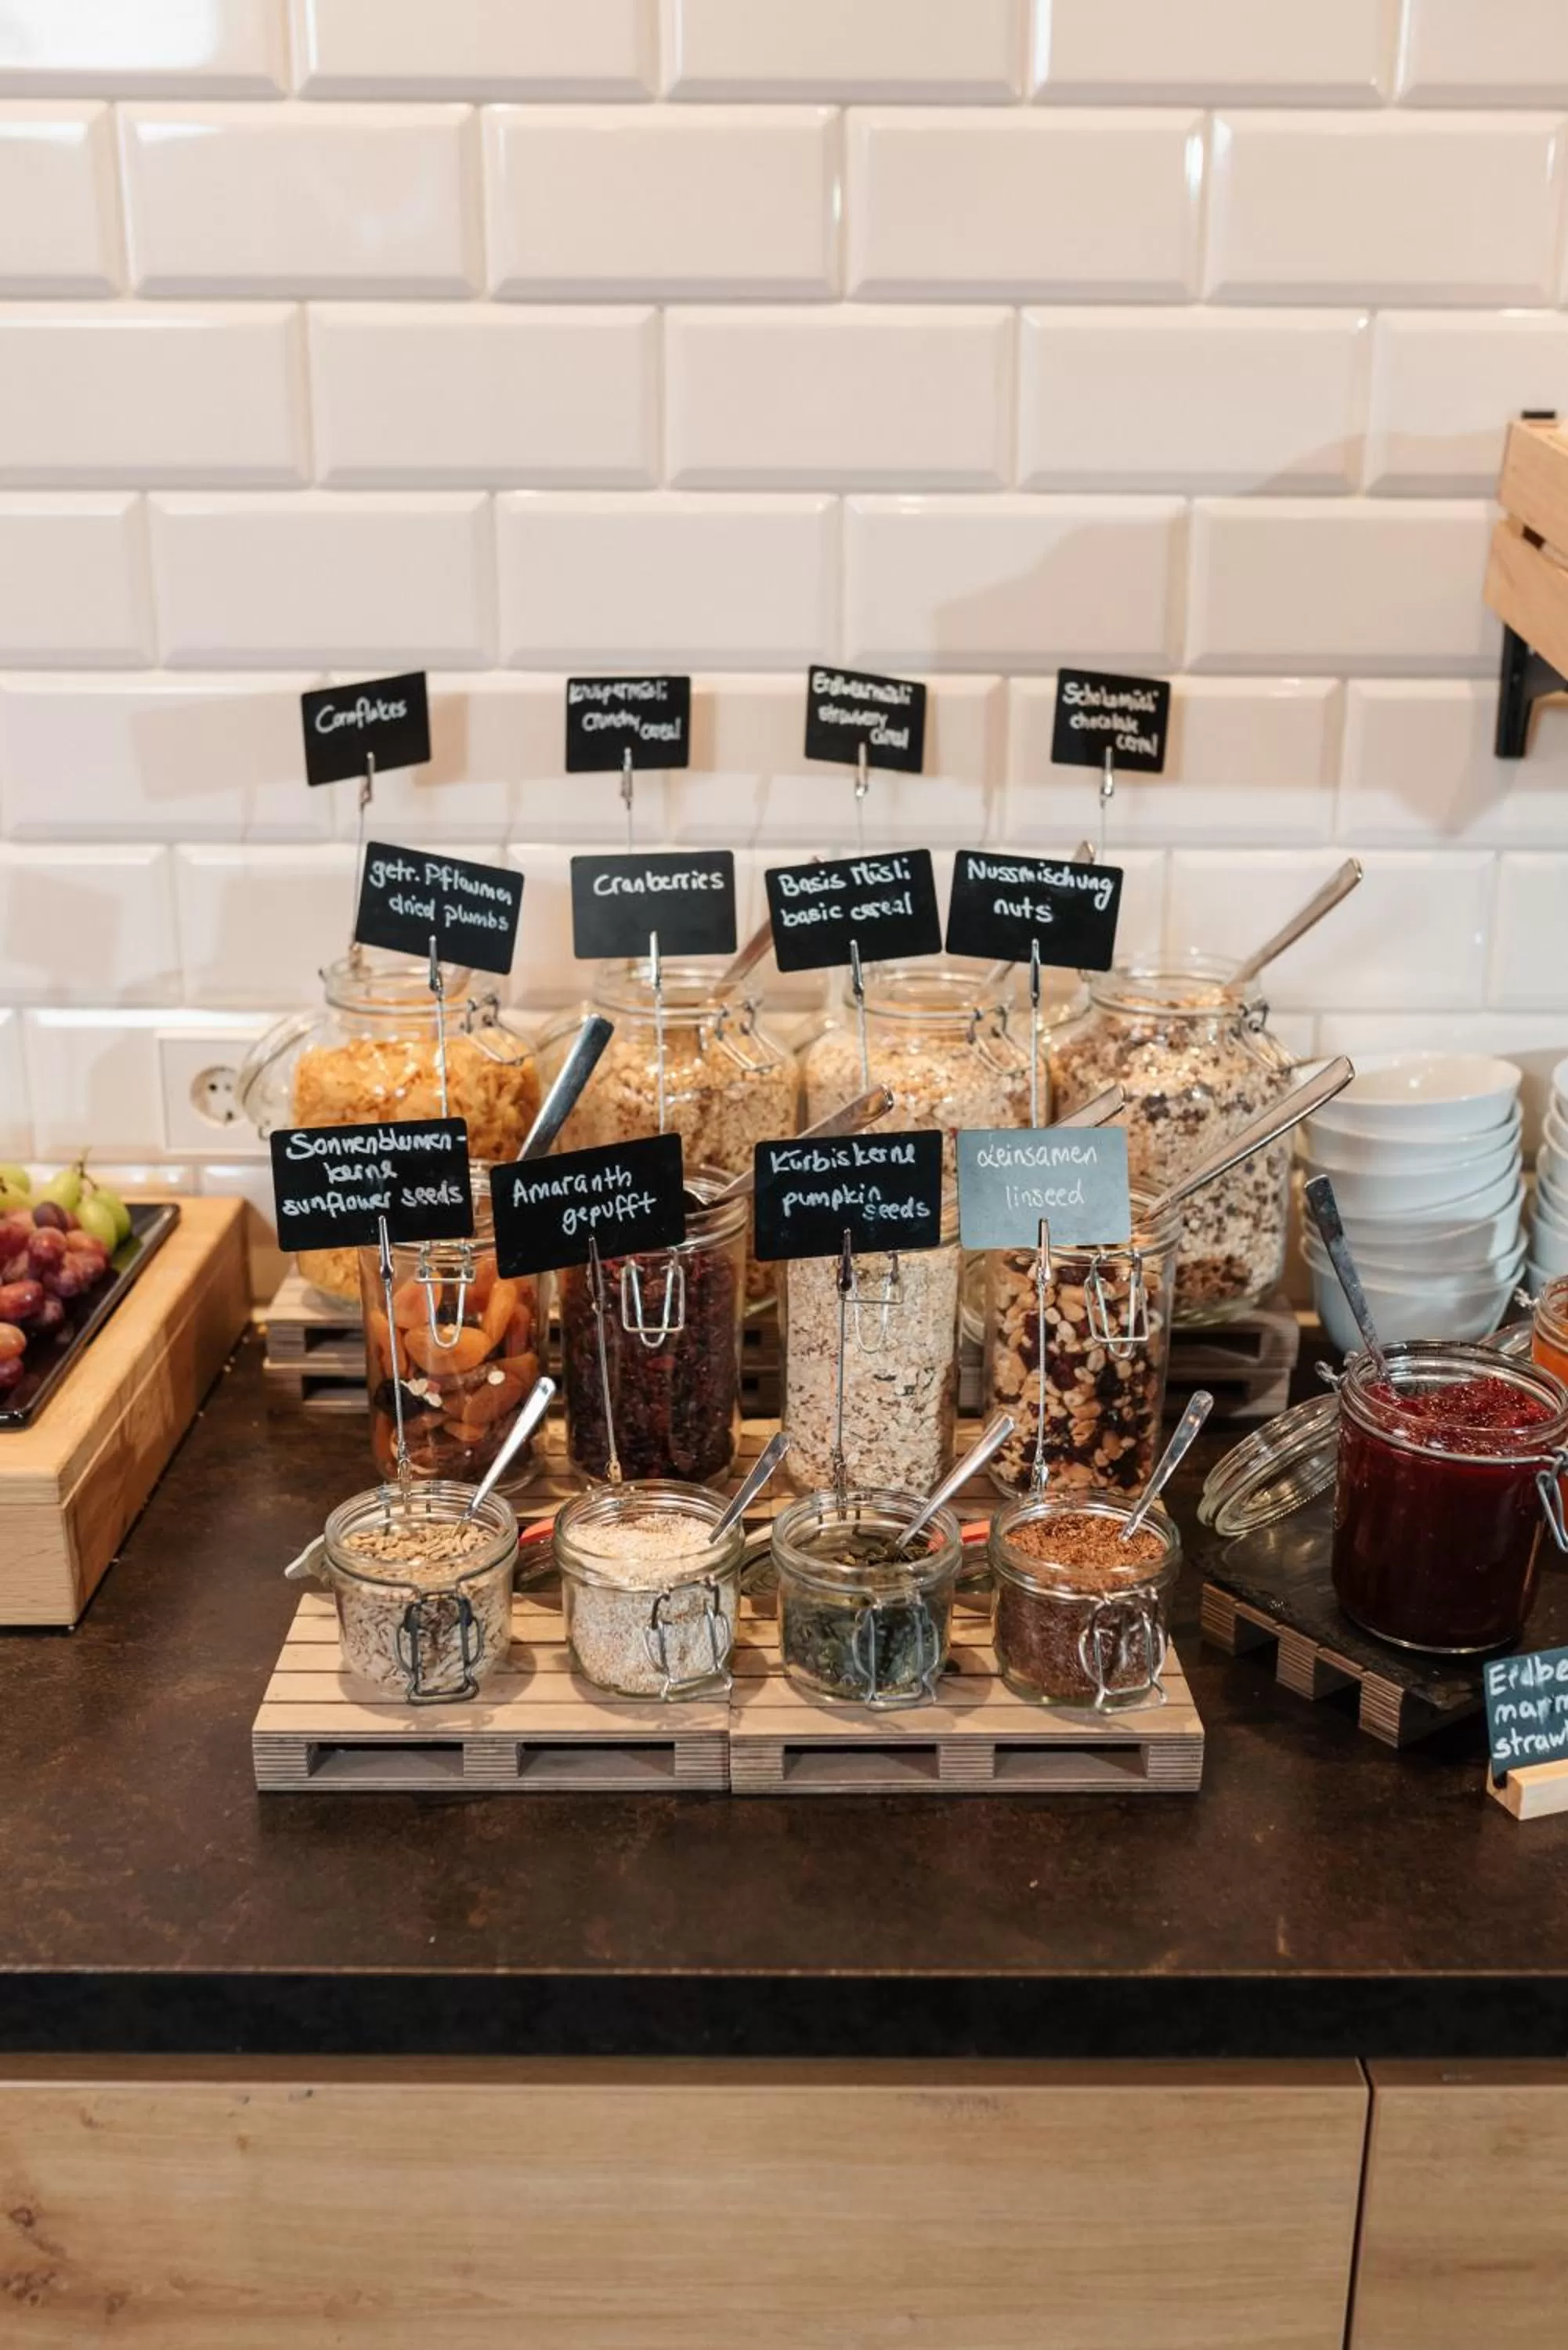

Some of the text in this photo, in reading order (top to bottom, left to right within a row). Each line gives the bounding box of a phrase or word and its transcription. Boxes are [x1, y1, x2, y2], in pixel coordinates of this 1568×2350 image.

[368, 859, 421, 889] getr.
[593, 869, 725, 896] Cranberries
[777, 870, 847, 897] Basis
[966, 857, 1115, 912] Nussmischung
[388, 892, 509, 931] dried plumbs
[780, 891, 913, 927] basic cereal
[992, 895, 1054, 924] nuts
[281, 1179, 464, 1219] sunflower seeds
[512, 1164, 633, 1208] Amaranth
[781, 1183, 931, 1221] pumpkin seeds
[1005, 1177, 1086, 1210] linseed
[561, 1191, 657, 1236] gepufft
[1491, 1719, 1568, 1760] straw
